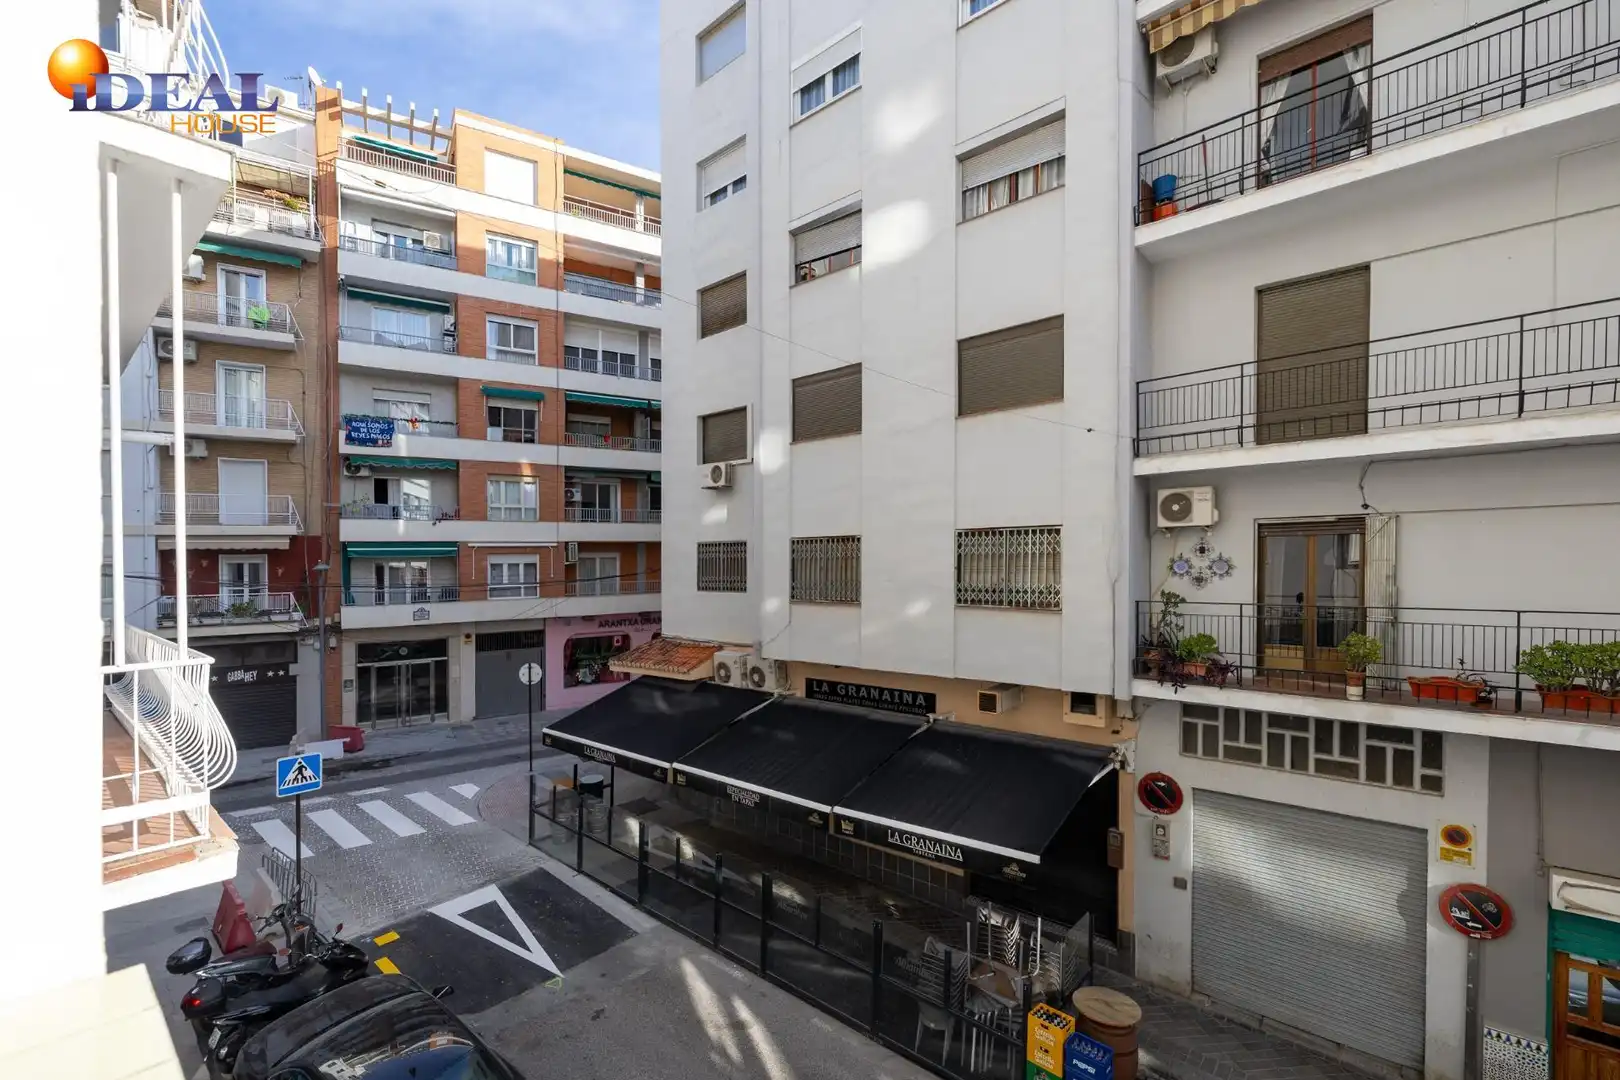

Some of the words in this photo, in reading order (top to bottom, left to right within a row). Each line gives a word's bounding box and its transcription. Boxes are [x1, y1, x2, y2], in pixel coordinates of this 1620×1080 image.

[351, 431, 370, 439] REYES
[598, 618, 641, 629] ARANTXA
[227, 669, 245, 682] GABBA
[244, 670, 258, 682] HEY
[813, 680, 830, 694] LA
[837, 683, 927, 706] GRANAINA
[887, 829, 901, 843] LA
[903, 834, 963, 861] GRANAINA
